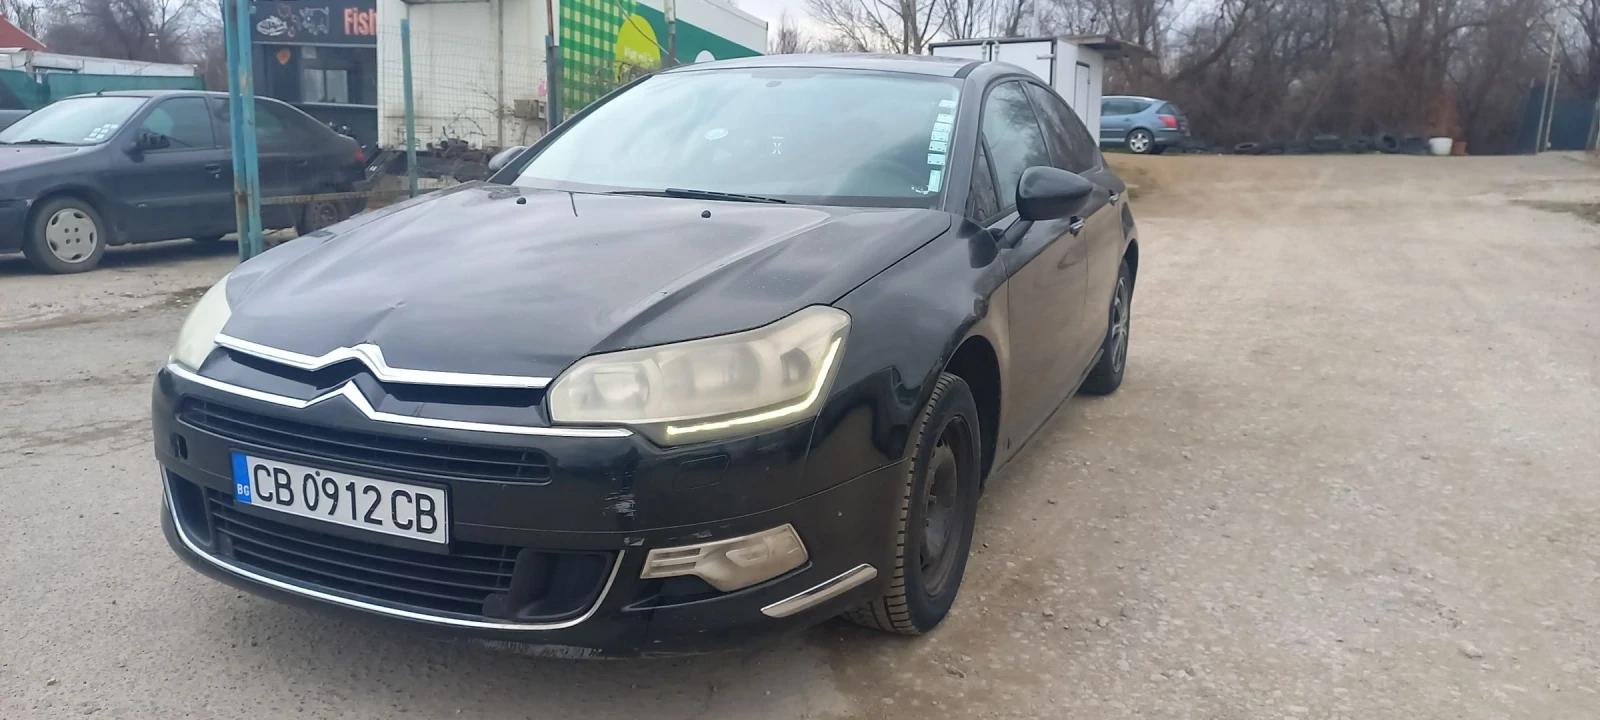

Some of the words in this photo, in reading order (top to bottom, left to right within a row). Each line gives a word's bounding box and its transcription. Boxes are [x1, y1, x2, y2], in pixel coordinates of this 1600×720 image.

[236, 483, 250, 497] BG
[253, 464, 294, 507] CB
[303, 473, 383, 526] 0912
[391, 489, 438, 535] CB
